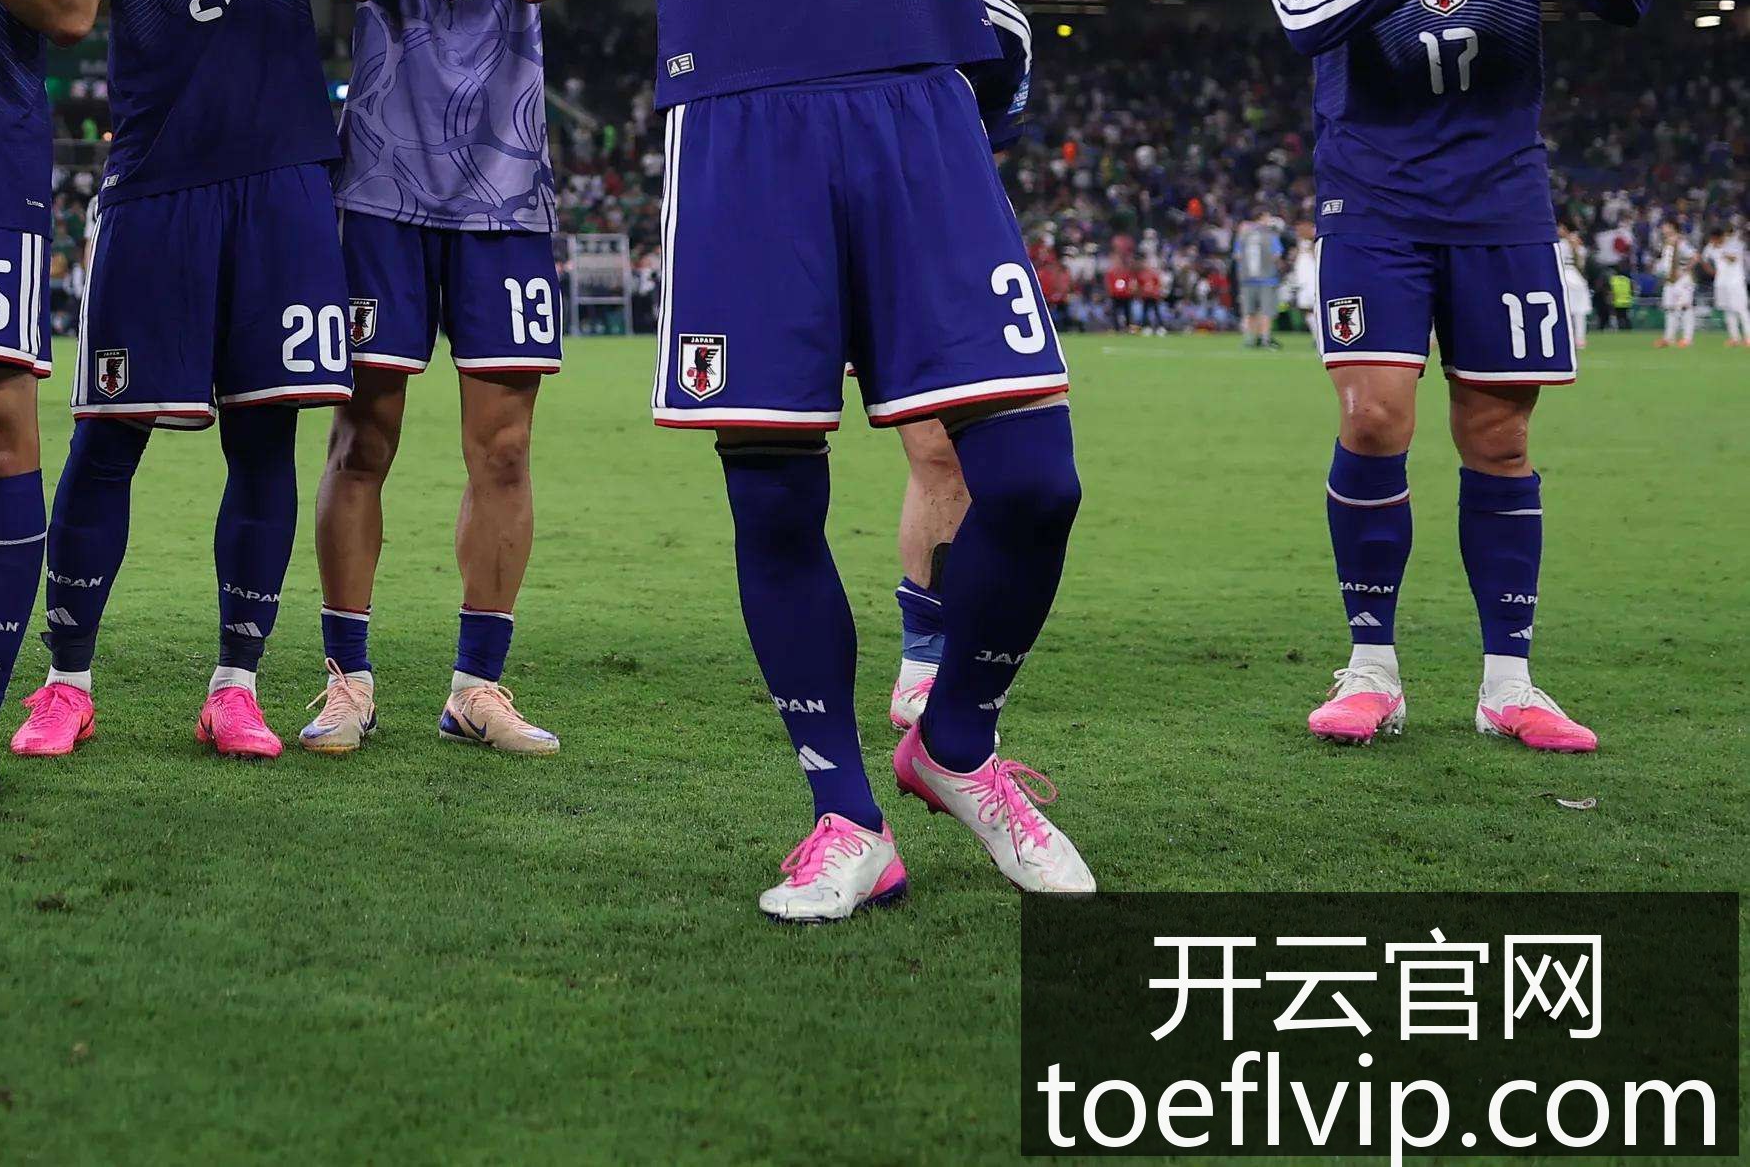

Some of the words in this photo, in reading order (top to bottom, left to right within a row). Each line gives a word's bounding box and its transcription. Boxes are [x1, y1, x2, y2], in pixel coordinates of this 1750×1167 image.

[1419, 27, 1479, 95] 17
[282, 304, 347, 372] 20
[504, 277, 554, 344] 13
[991, 262, 1045, 354] 3
[1502, 291, 1558, 359] 17
[47, 566, 103, 588] APAN
[771, 693, 826, 713] PAN
